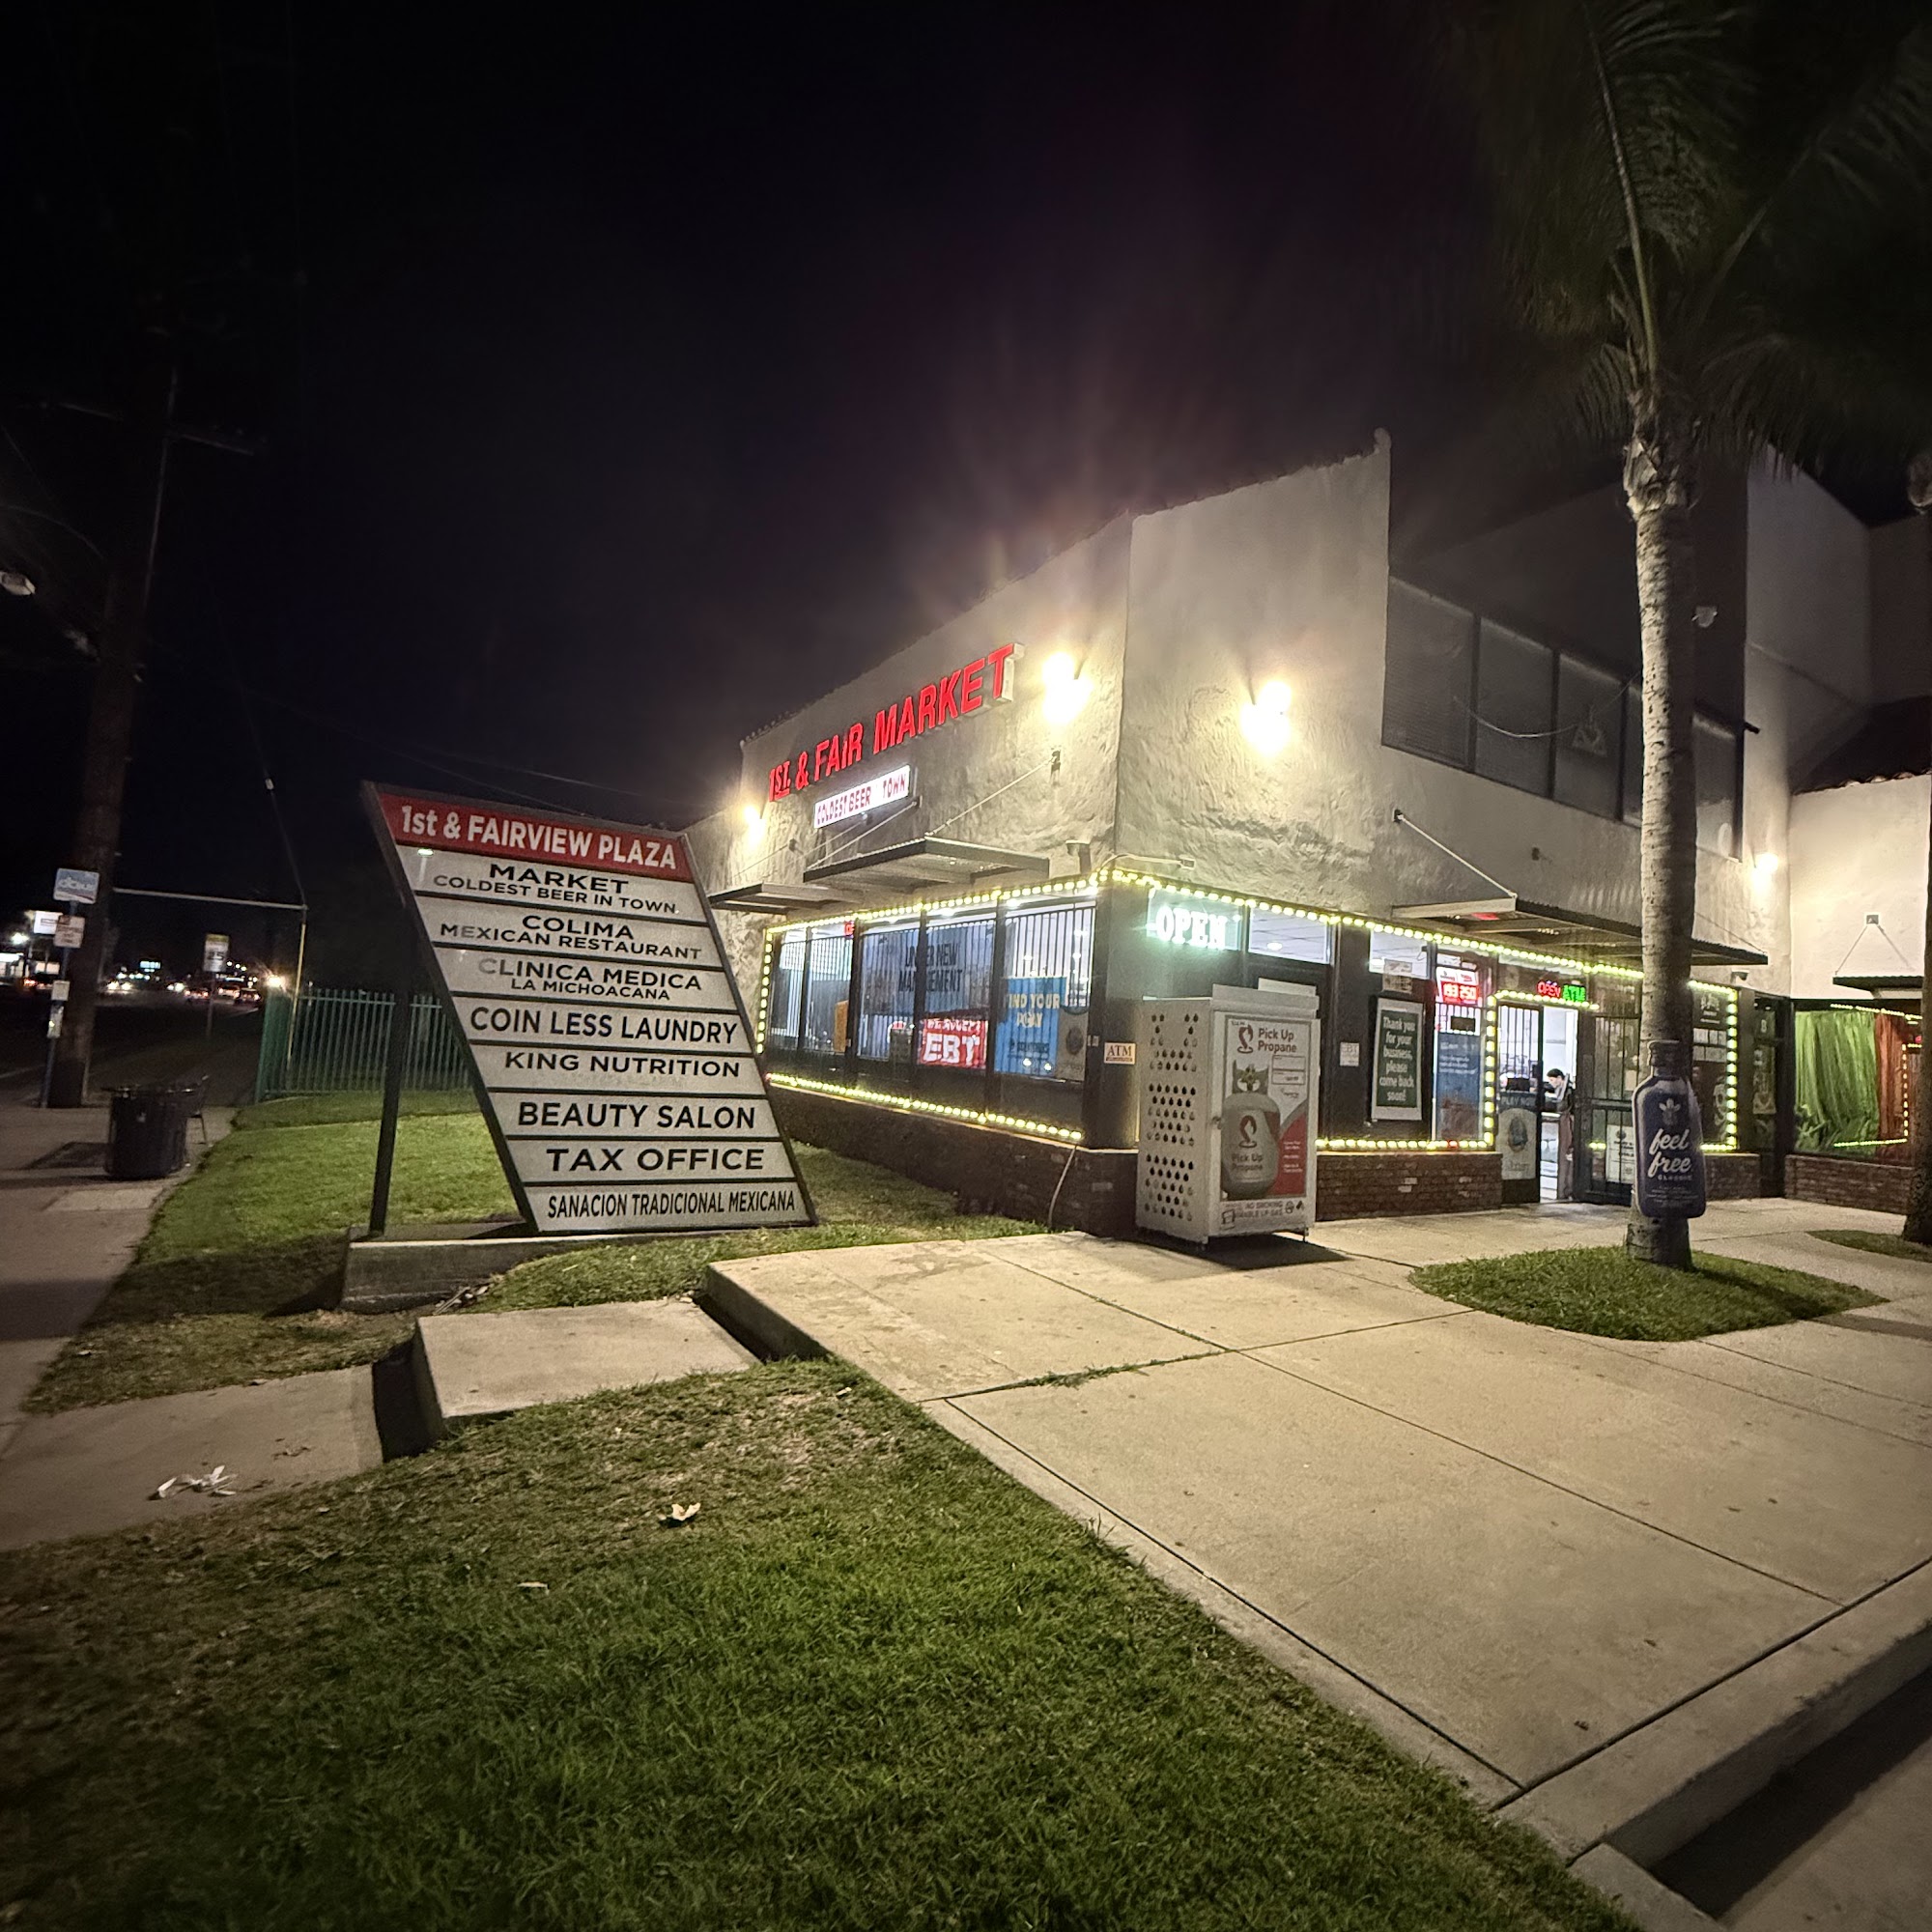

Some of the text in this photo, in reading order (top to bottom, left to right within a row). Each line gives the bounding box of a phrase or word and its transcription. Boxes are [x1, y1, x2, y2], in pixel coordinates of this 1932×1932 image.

[795, 752, 809, 790] &
[814, 723, 864, 781] FAIR
[873, 643, 1013, 754] MARKET
[849, 786, 871, 811] BEER
[883, 774, 906, 798] TOWN
[402, 806, 676, 869] 1st & FAIRVIEW PLAZA
[490, 864, 628, 894] MARKET
[434, 875, 676, 914] COLDEST BEER IN TOWN
[440, 923, 701, 959] MEXICAN RESTAURANT
[523, 916, 634, 939] COLIMA
[1156, 905, 1227, 950] OPEN
[479, 958, 702, 990] CLINICA MEDICA
[511, 979, 670, 1000] LA MICHOACANA
[1008, 994, 1060, 1009] IND YOUR
[1537, 981, 1561, 998] OPEN
[470, 1007, 737, 1044] COIN LESS LAUNDRY
[1259, 1028, 1294, 1041] Pick Up
[1383, 1016, 1416, 1034] Thank you
[1385, 1031, 1397, 1043] for
[923, 1033, 980, 1065] EBT
[1107, 1045, 1131, 1057] ATM
[1258, 1040, 1297, 1053] Propane
[505, 1051, 739, 1077] KING NUTRITION
[518, 1102, 754, 1129] BEAUTY SALON
[1648, 1127, 1690, 1154] feel
[547, 1149, 764, 1172] TAX OFFICE
[1648, 1151, 1691, 1178] free
[548, 1190, 795, 1218] SANACION TRADICIONAL MEXICANA
